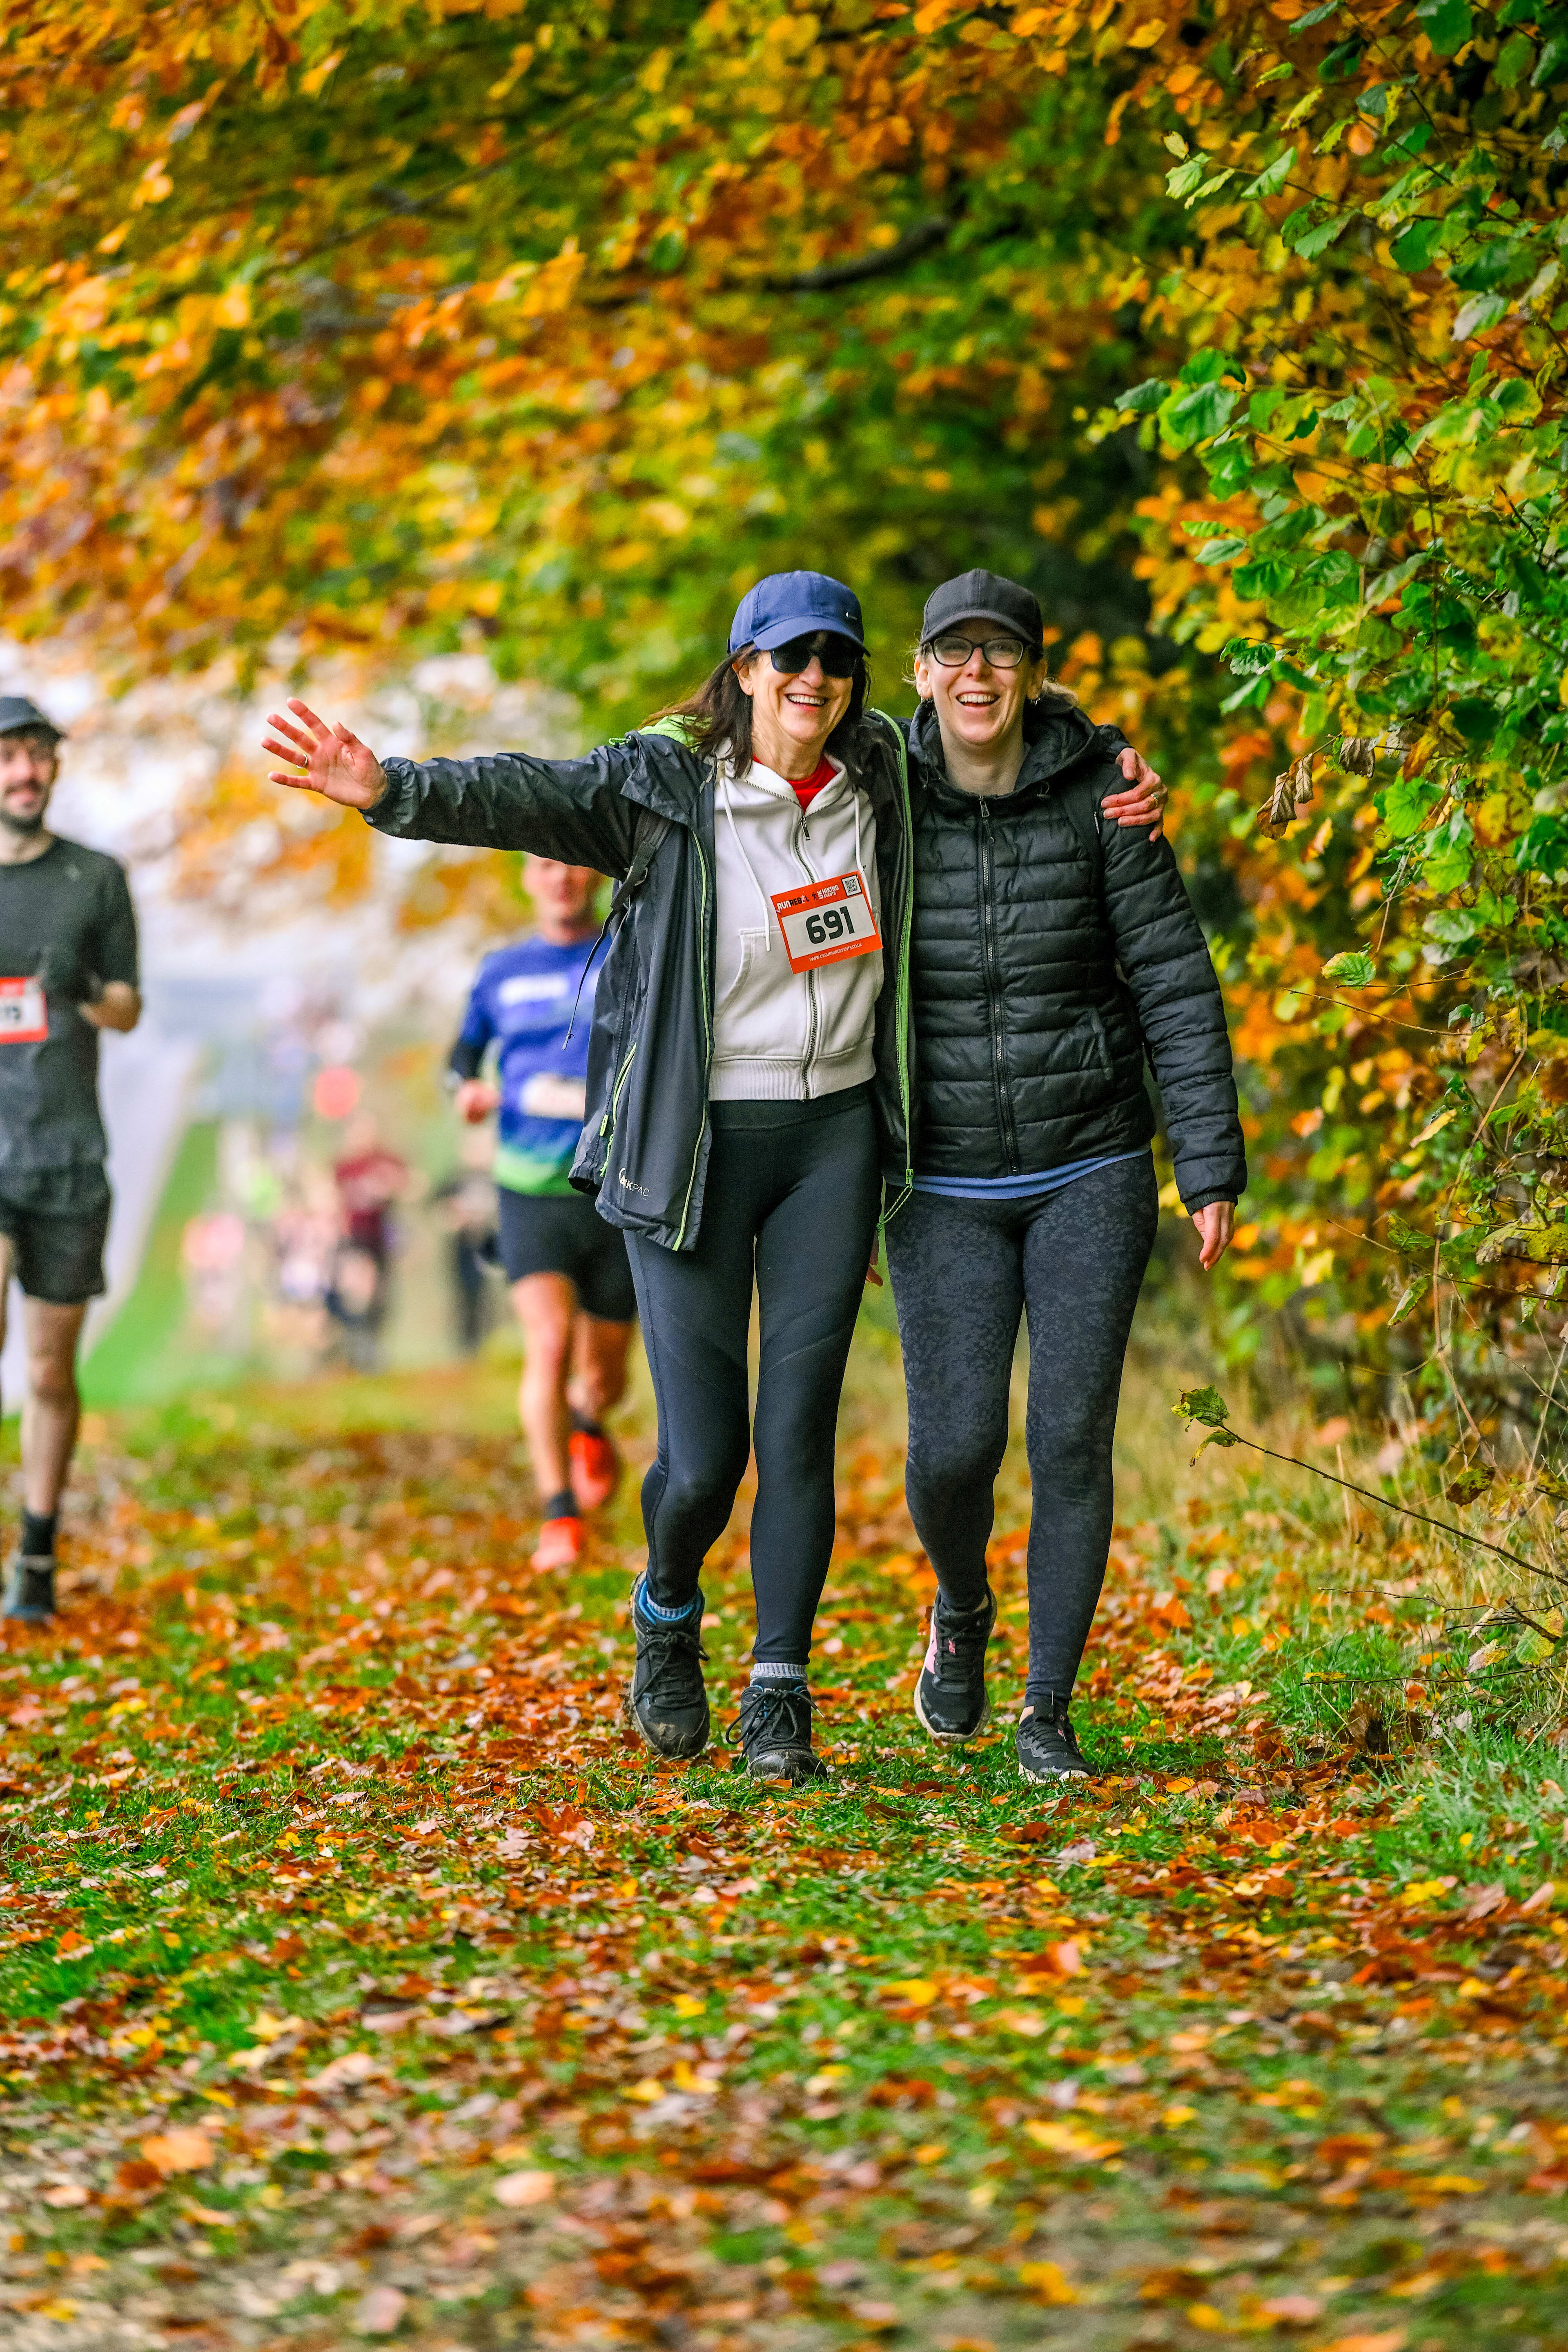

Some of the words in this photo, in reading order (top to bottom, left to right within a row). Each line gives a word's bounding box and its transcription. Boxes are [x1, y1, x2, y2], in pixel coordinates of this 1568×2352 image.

[817, 890, 824, 900] UK
[822, 885, 839, 894] HIKING
[806, 906, 855, 944] 691
[809, 943, 862, 961] WWW.UKRUNNINGEVENTS.CO.UK
